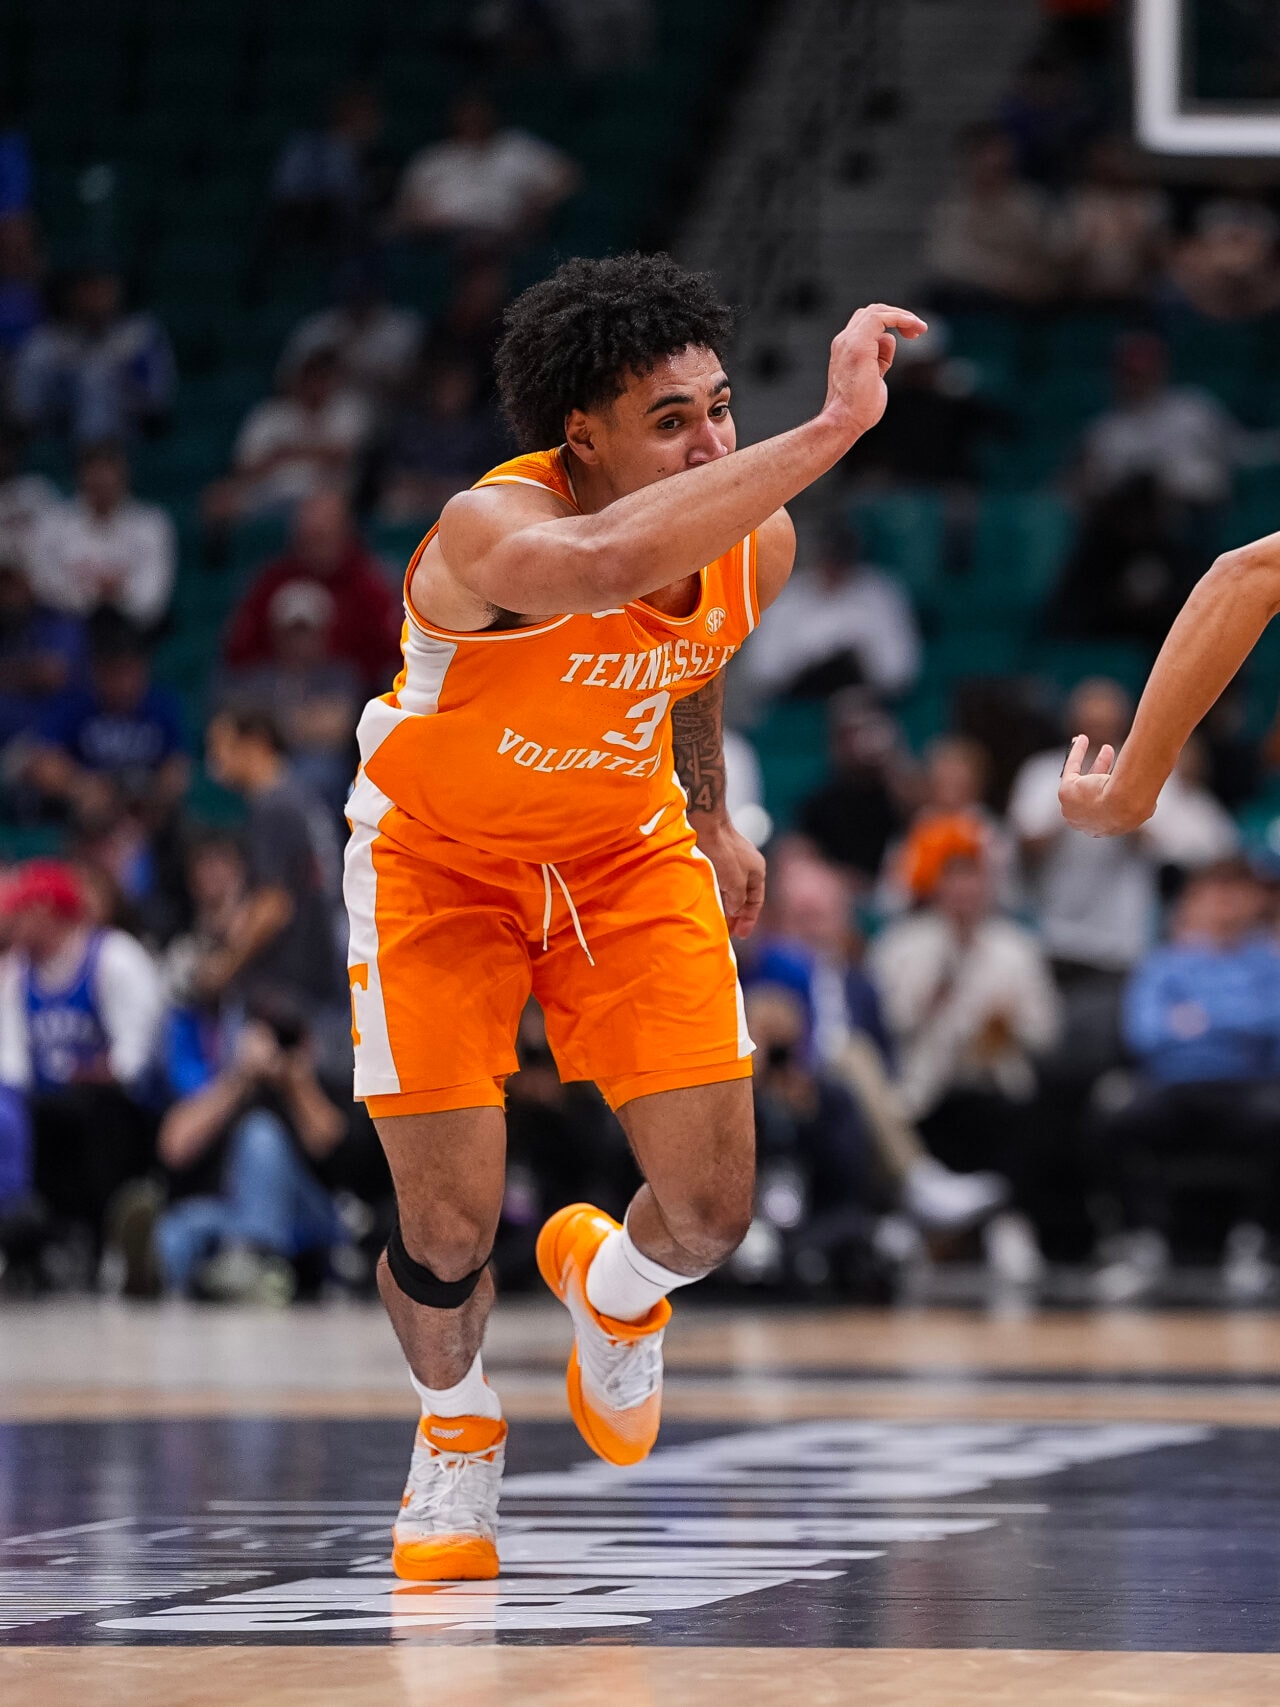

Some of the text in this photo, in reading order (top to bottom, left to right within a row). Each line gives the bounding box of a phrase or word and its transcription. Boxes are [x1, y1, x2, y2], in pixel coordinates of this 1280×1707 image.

[706, 608, 725, 634] SEC
[601, 690, 671, 752] 3
[497, 728, 661, 779] VOLUNTE
